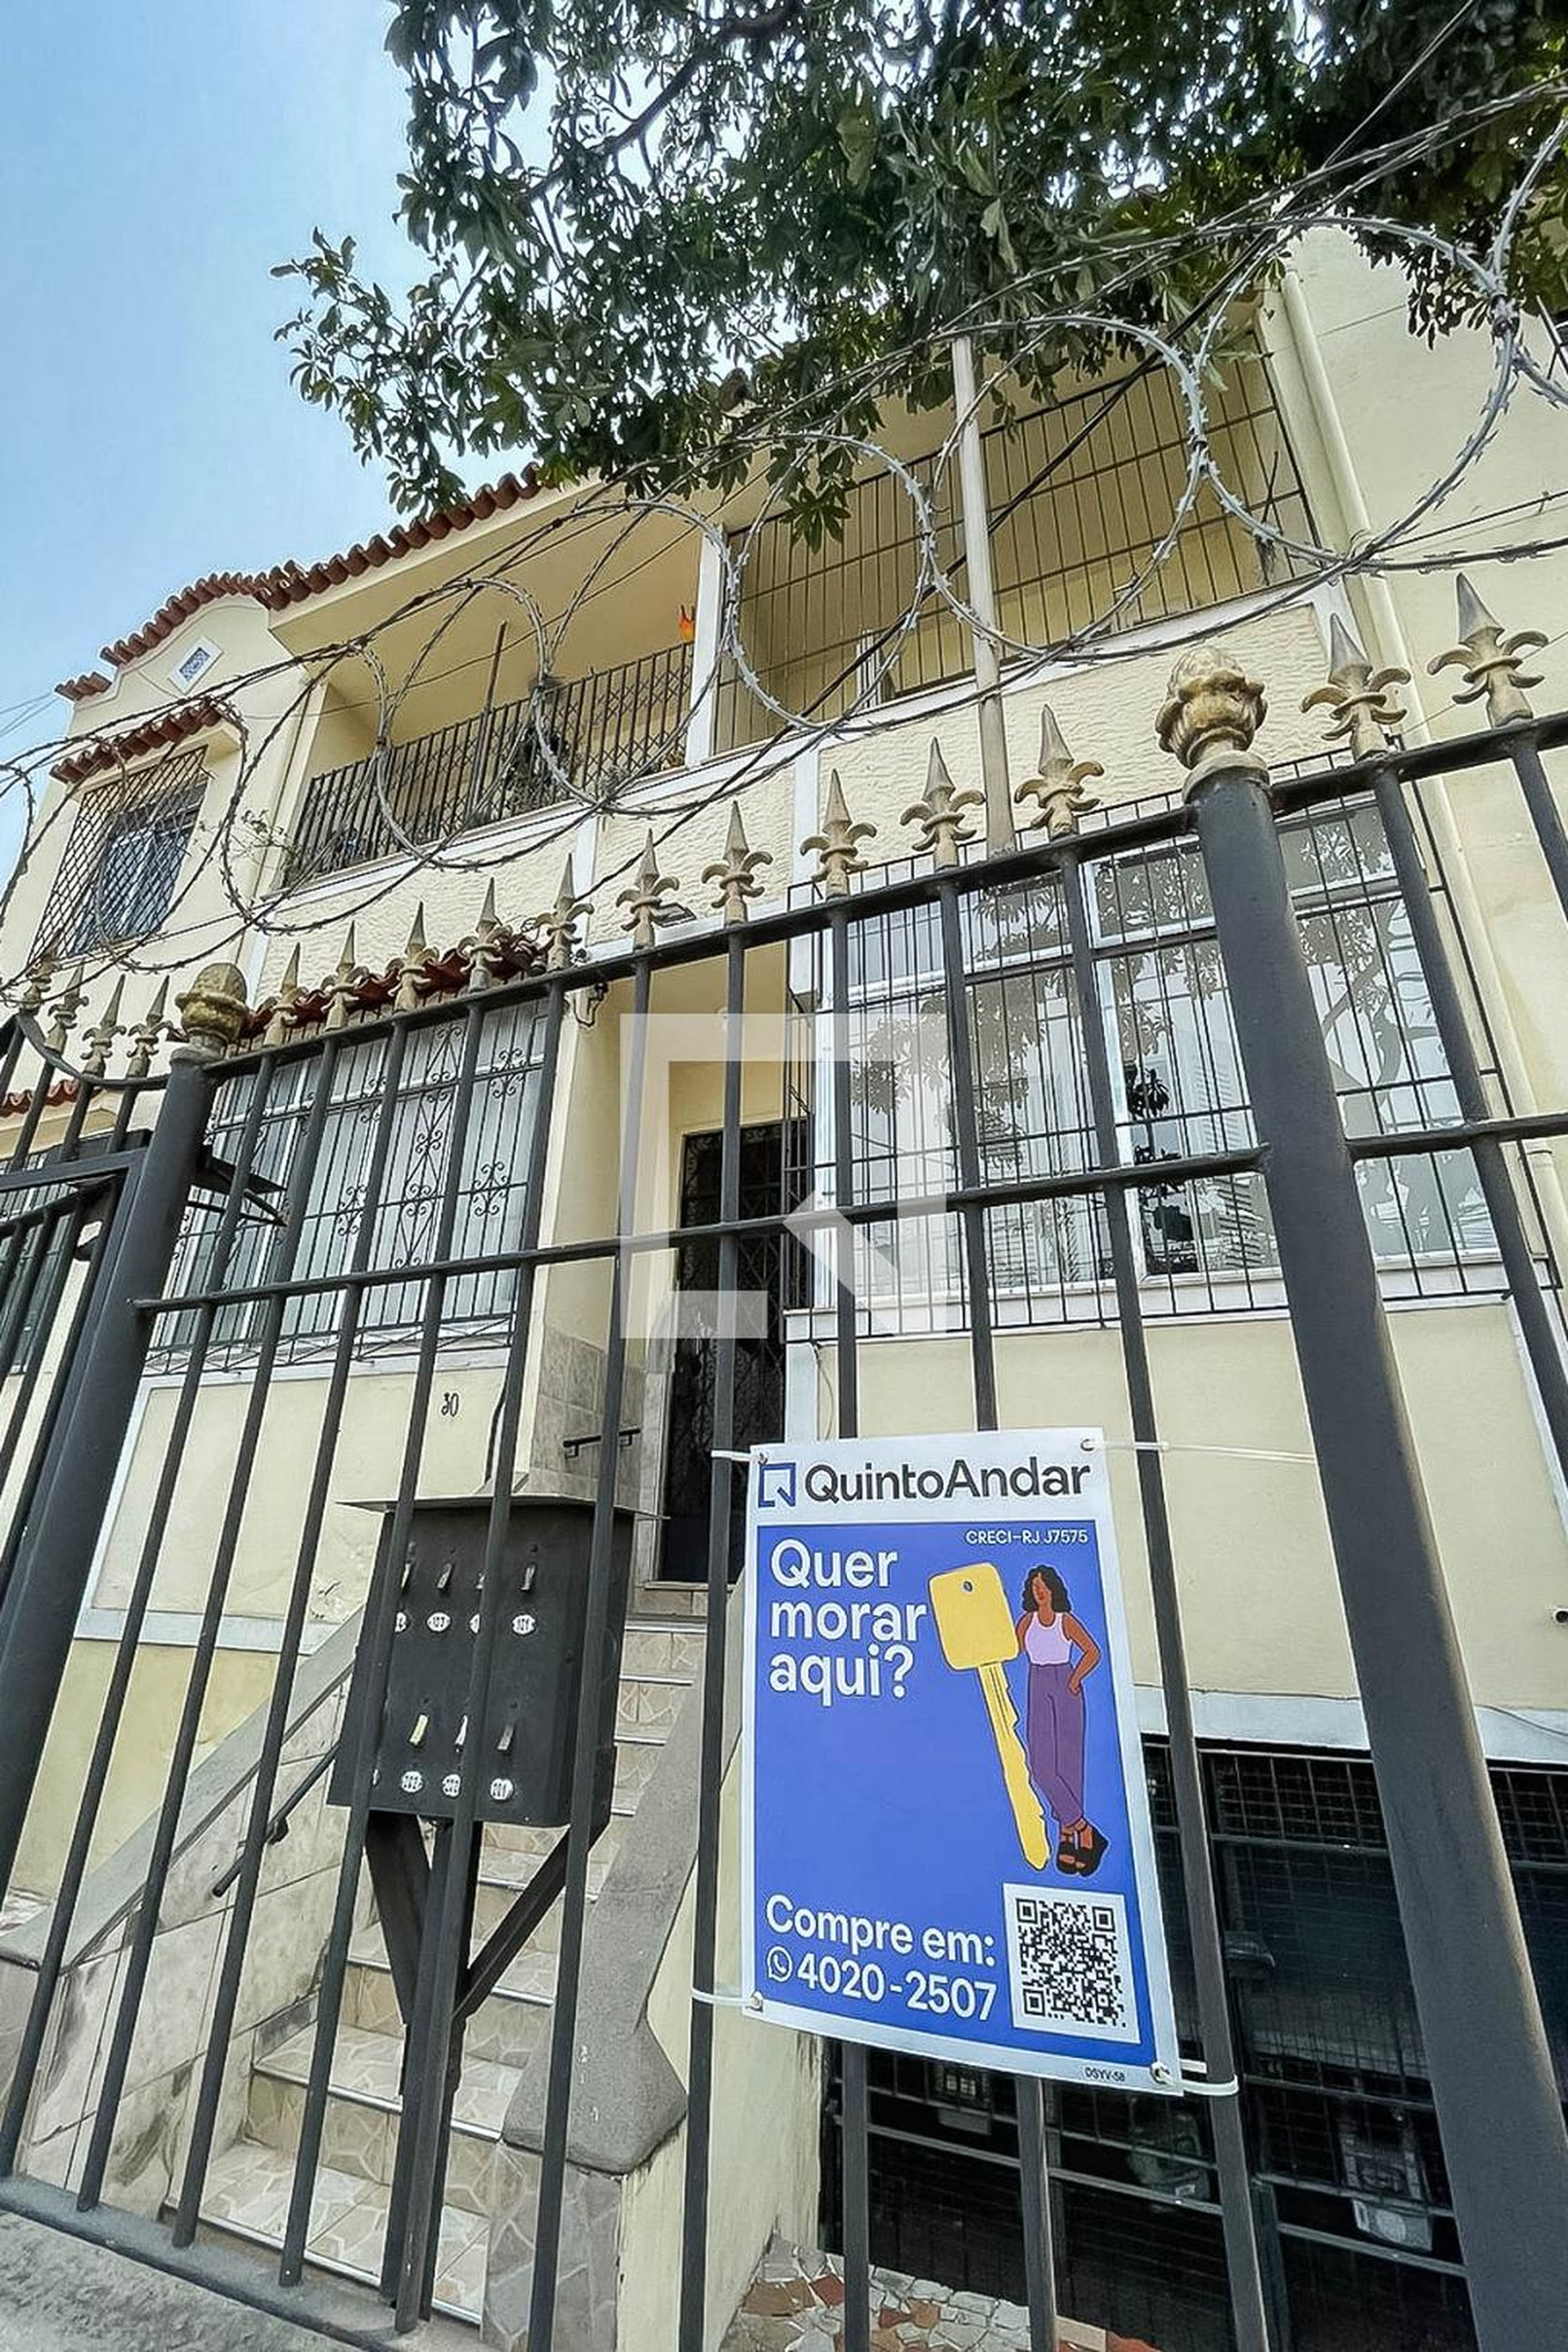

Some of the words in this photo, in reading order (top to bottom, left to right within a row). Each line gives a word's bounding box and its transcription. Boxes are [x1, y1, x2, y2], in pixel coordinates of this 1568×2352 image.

[805, 1457, 1091, 1504] QuintoAndar
[966, 1530, 1040, 1544] CRECI-RJ
[1043, 1530, 1088, 1544] J7575
[771, 1538, 898, 1588] Quer
[771, 1601, 928, 1642] morar
[768, 1644, 915, 1707] aqui?
[766, 1894, 913, 1956] Compre
[922, 1924, 996, 1967] em:
[797, 1953, 997, 2021] 4020-2507
